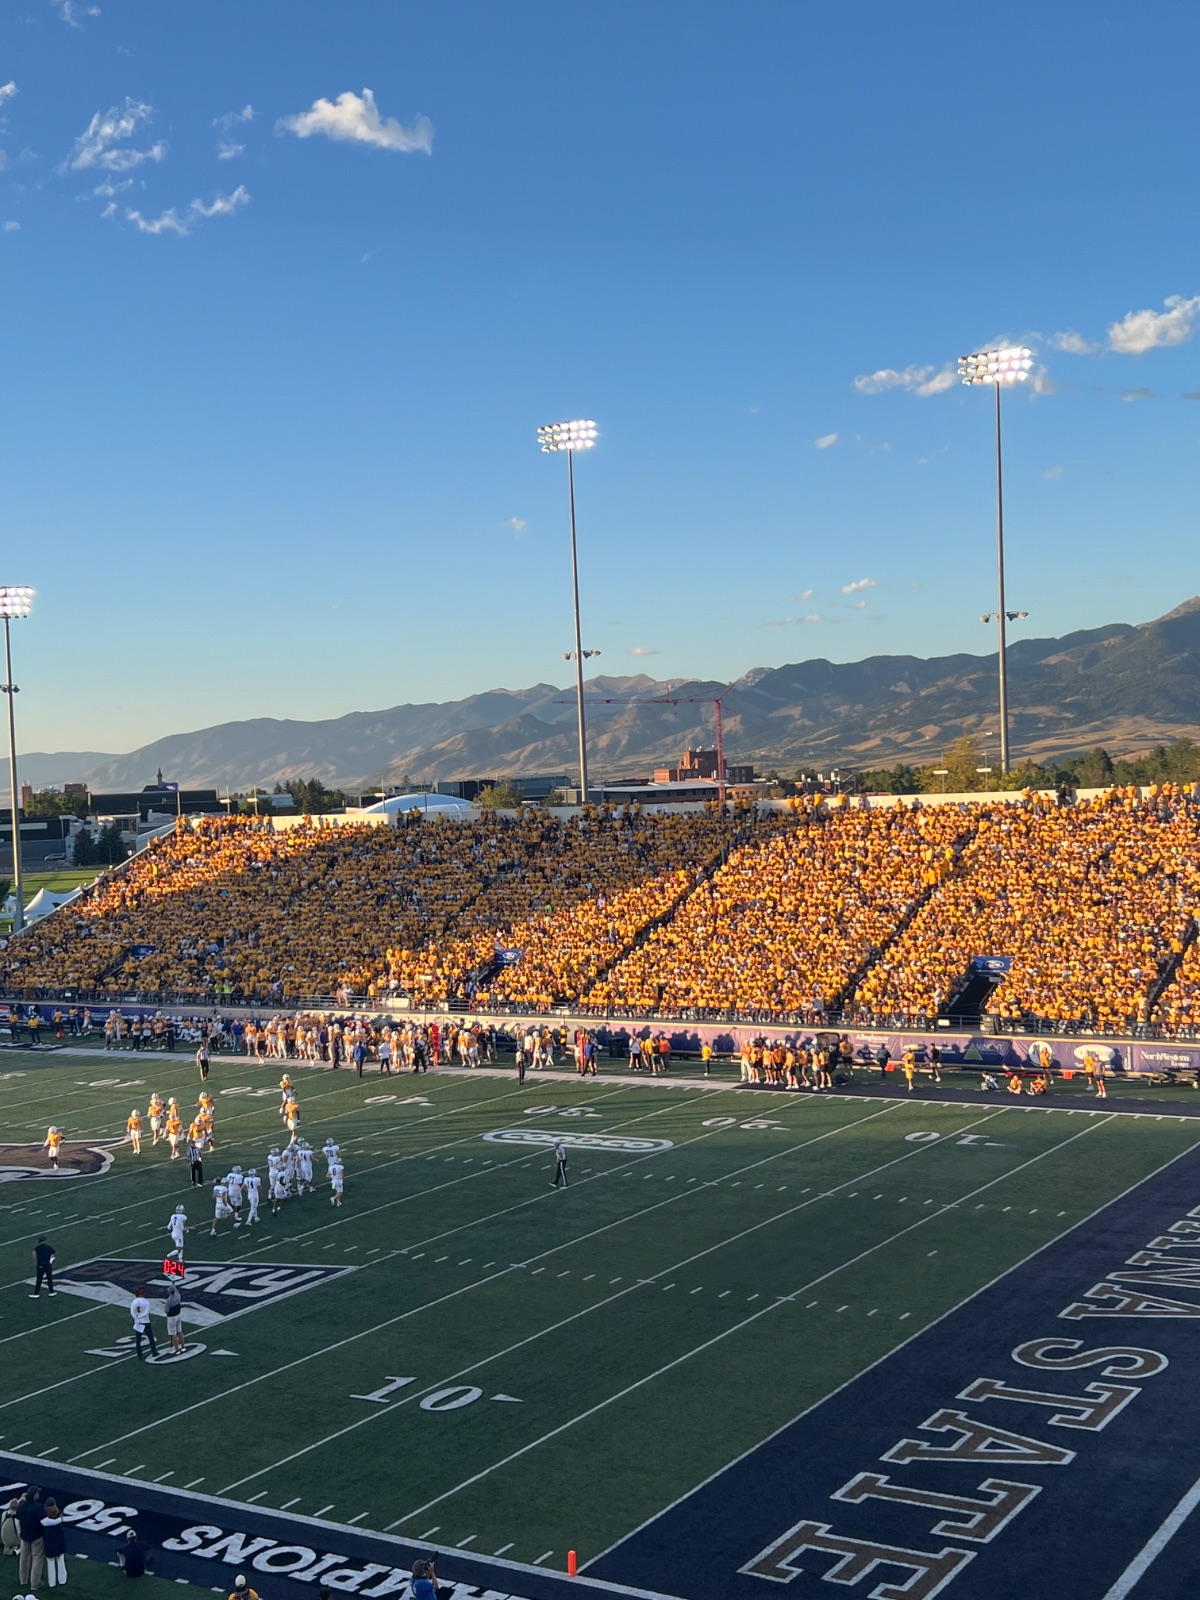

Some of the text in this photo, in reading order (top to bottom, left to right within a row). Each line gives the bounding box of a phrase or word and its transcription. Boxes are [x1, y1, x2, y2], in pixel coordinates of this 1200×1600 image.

[1140, 1050, 1190, 1062] NorthWestern
[523, 1105, 596, 1117] 30
[701, 1116, 782, 1130] 20
[904, 1131, 990, 1146] 10
[83, 1335, 207, 1365] 20
[349, 1376, 483, 1411] 10
[737, 1337, 1169, 1600] STATE
